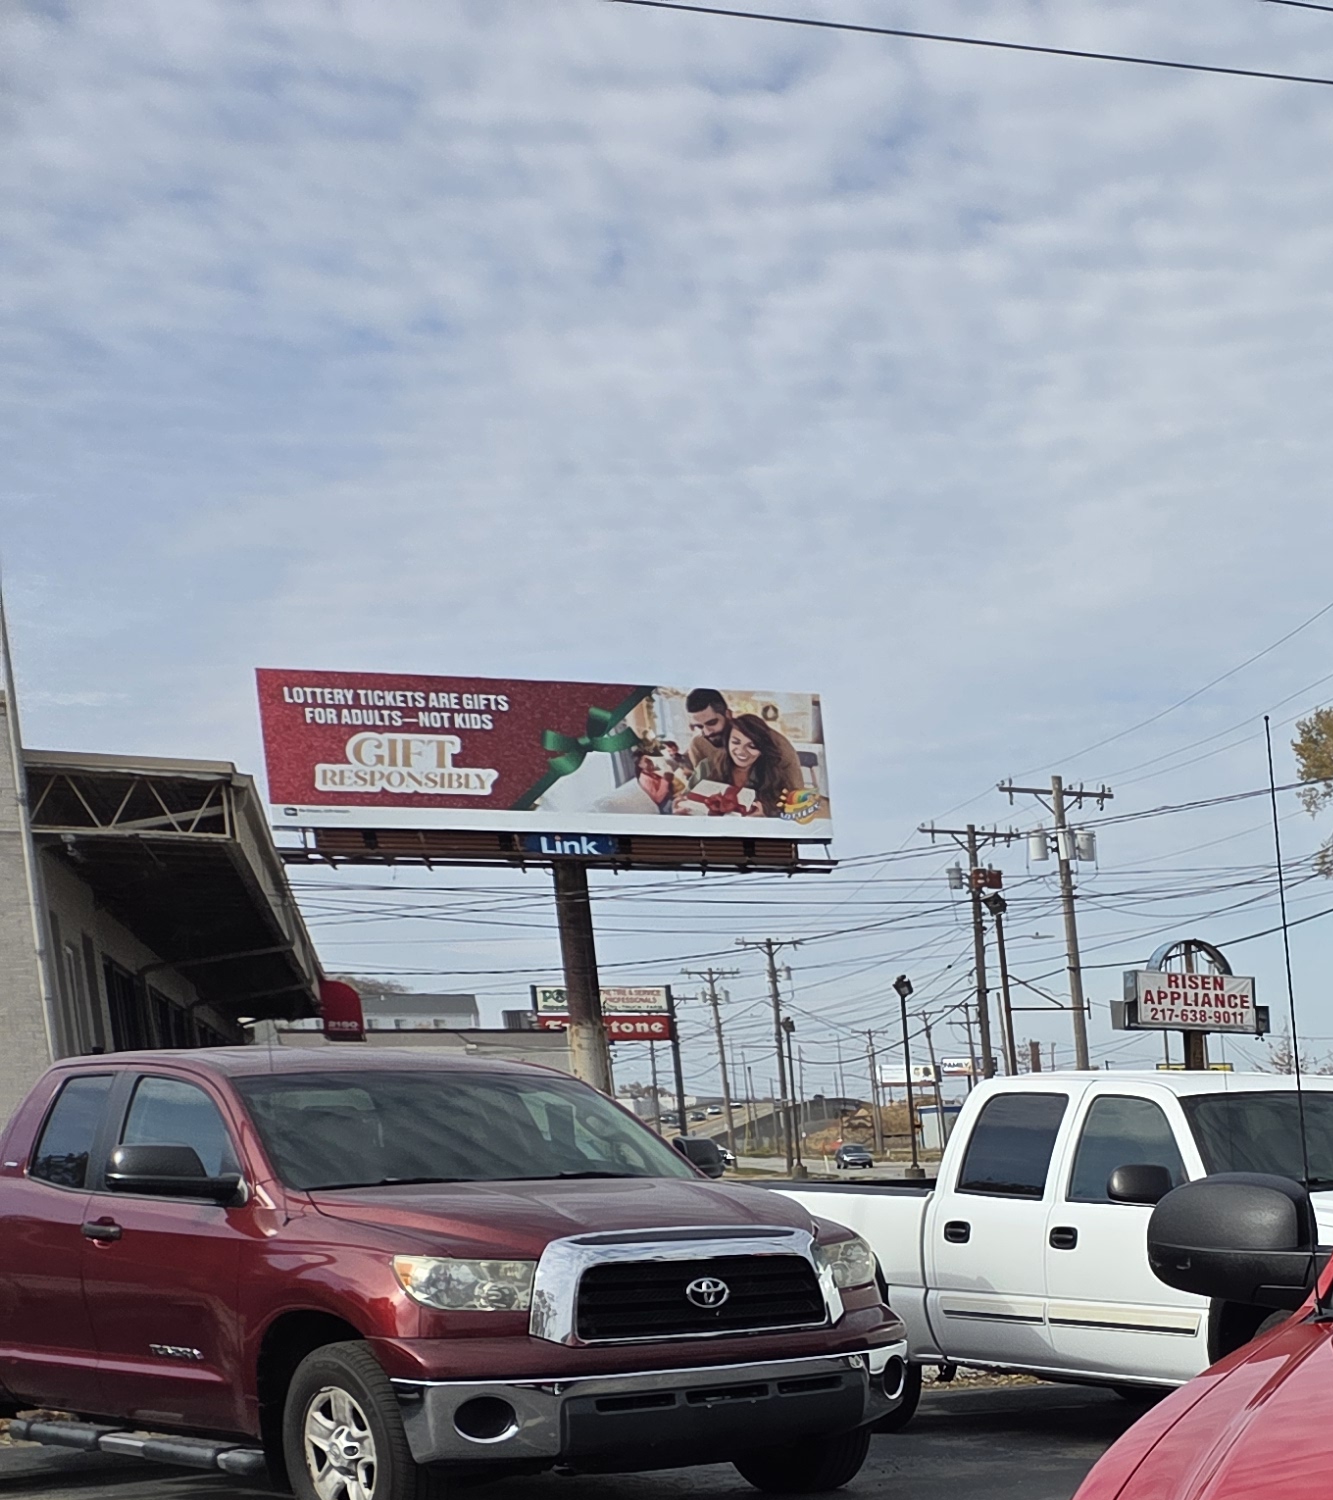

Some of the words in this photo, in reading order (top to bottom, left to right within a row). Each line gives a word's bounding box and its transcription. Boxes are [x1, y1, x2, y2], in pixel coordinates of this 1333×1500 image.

[283, 686, 354, 705] LOTTERY
[356, 689, 425, 709] TICKETS
[428, 692, 461, 709] ARE
[462, 693, 509, 711] GIFTS
[304, 707, 338, 725] FOR
[454, 712, 494, 730] KIDS
[351, 736, 456, 769] GIFT
[320, 768, 492, 791] RESPONSIBLY
[539, 835, 603, 856] Link
[1167, 973, 1225, 992] RISEN
[1143, 989, 1250, 1010] APPLIANCE
[1150, 1007, 1244, 1025] 217-638-9011
